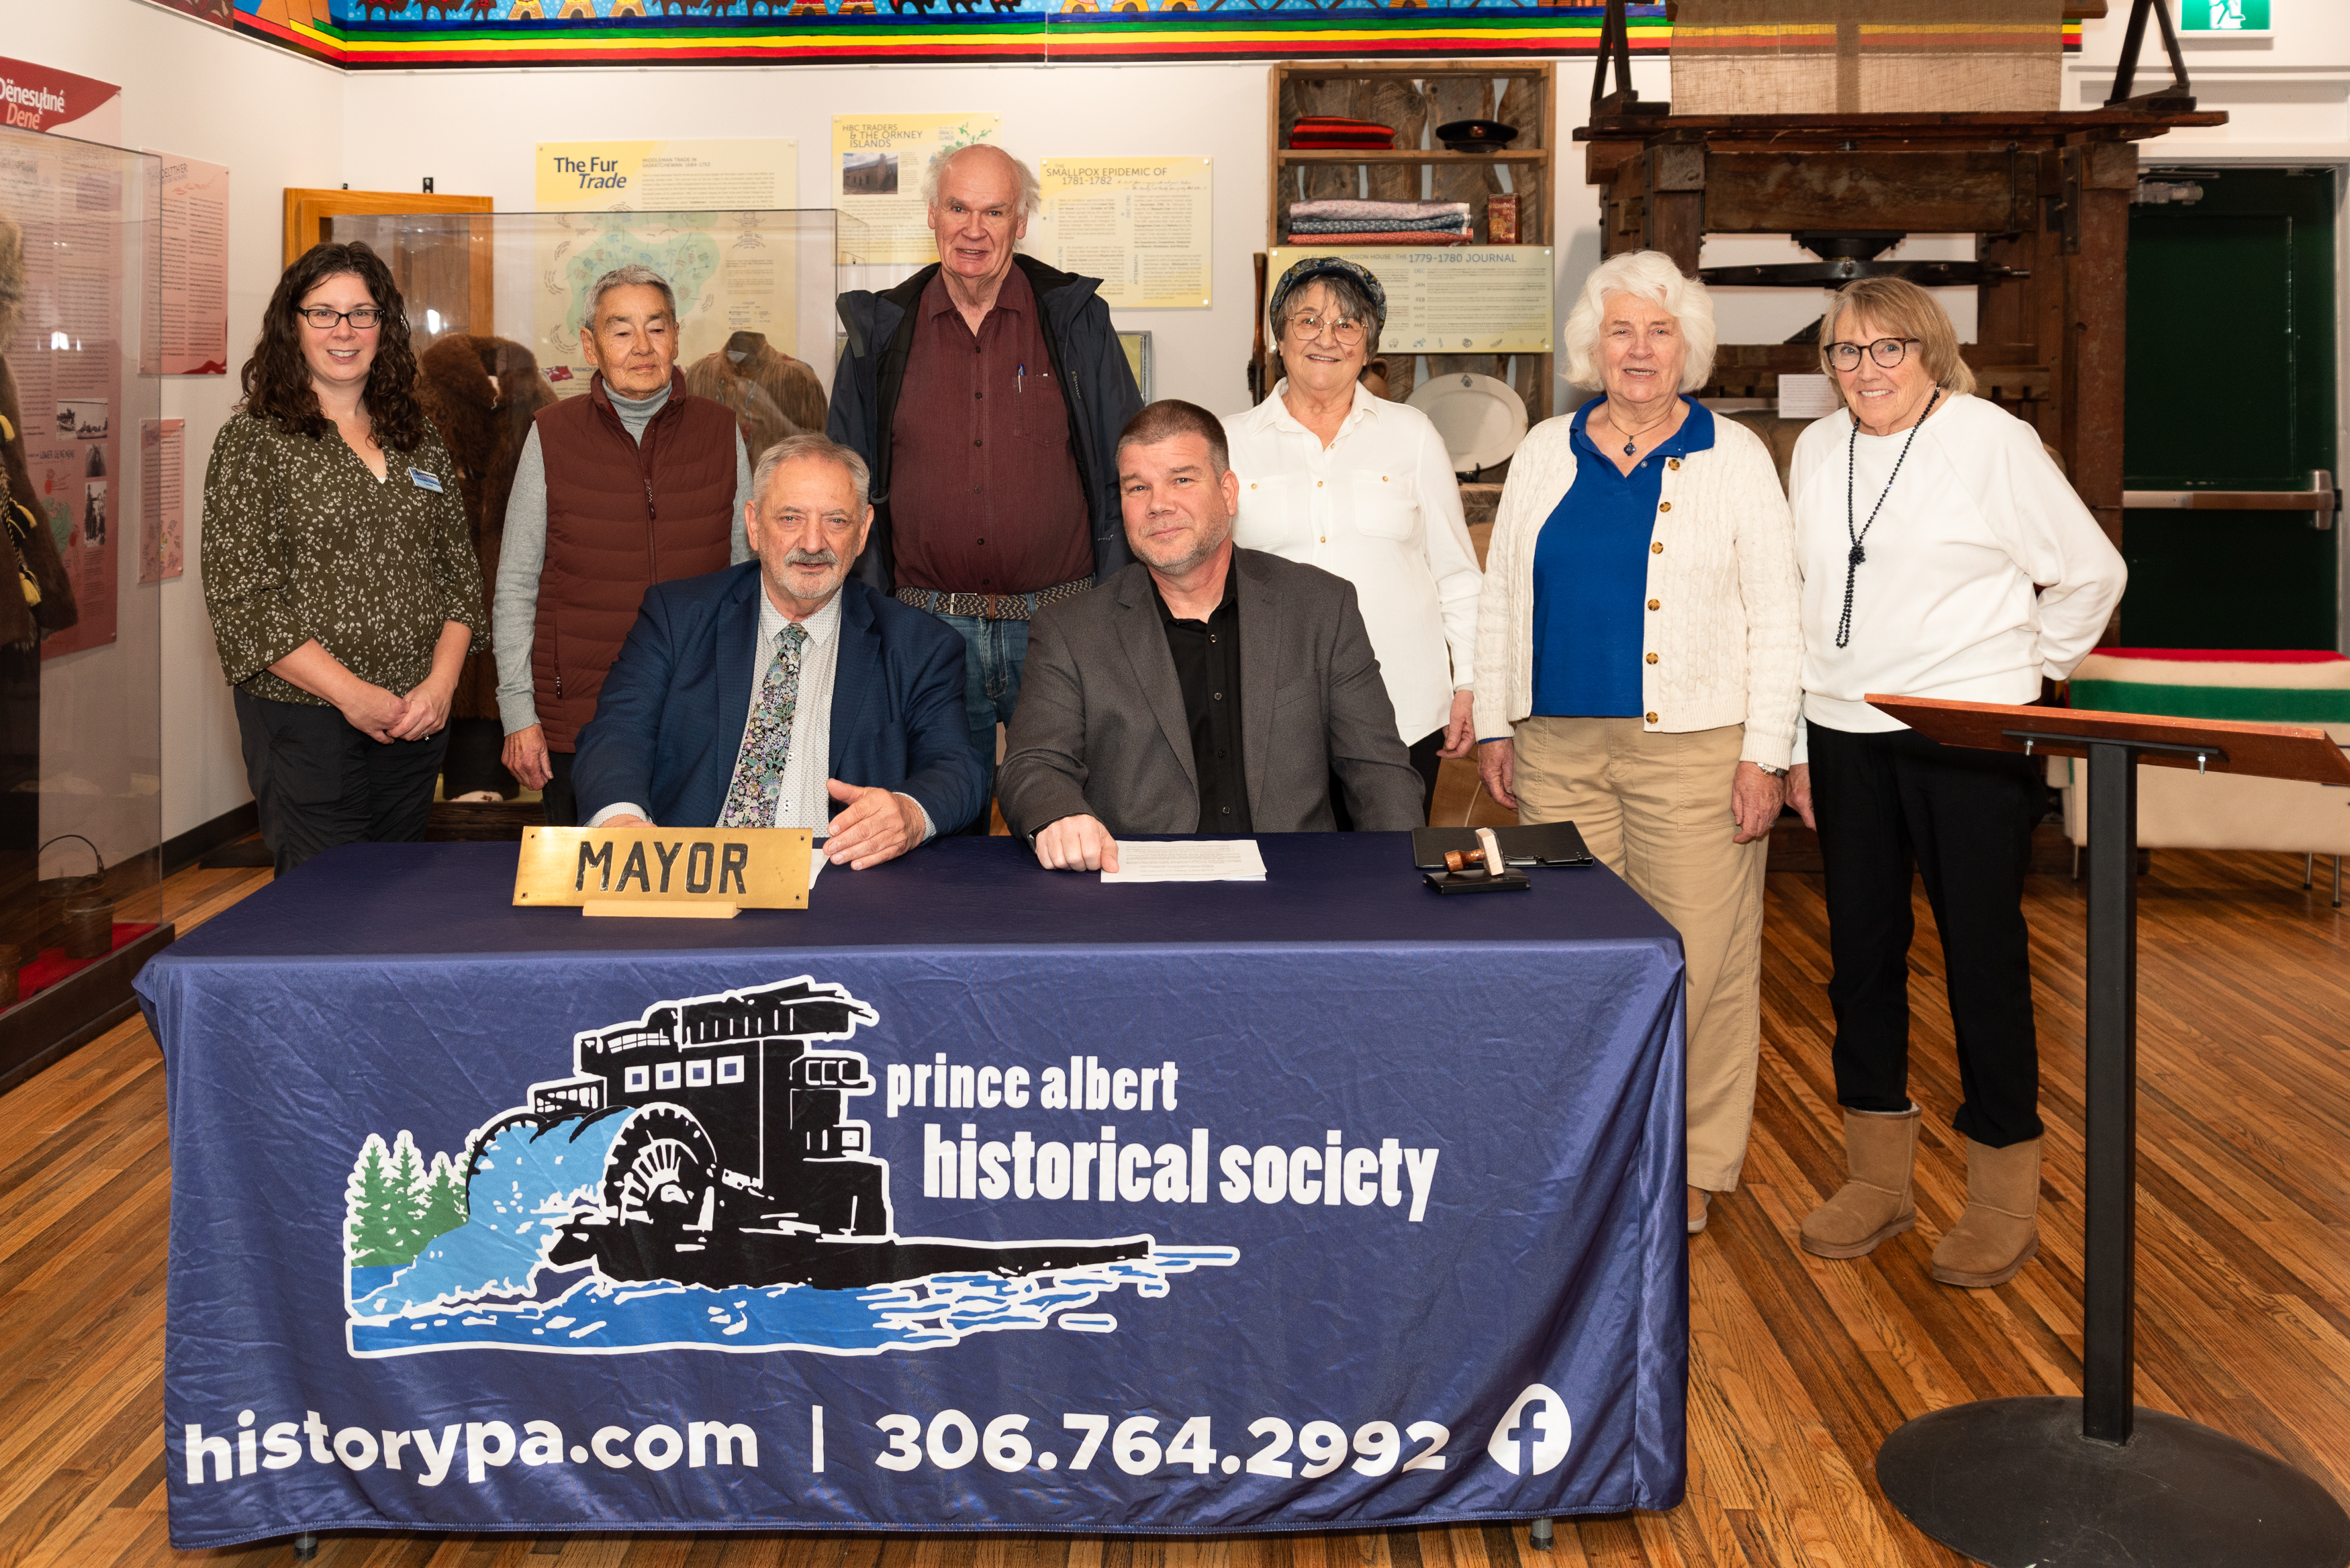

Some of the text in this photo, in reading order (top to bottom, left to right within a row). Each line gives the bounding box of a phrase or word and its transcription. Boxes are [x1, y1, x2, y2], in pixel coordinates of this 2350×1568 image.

[6, 102, 41, 130] Dene
[882, 131, 923, 139] ORKNEY
[850, 139, 892, 148] ISLANDS
[554, 157, 618, 173] The Fur
[1046, 167, 1167, 177] SMALLPOX EPIDEMIC OF
[579, 173, 627, 189] Trade
[1062, 177, 1113, 185] 1781-1782
[1409, 254, 1463, 263] 1779-1780
[1466, 253, 1516, 262] JOURNAL
[575, 840, 749, 894] MAYOR
[887, 1052, 1178, 1118] prince albert
[923, 1122, 1440, 1222] historical society
[184, 1410, 759, 1487] historypa.com
[874, 1408, 1450, 1479] 306.764.2992
